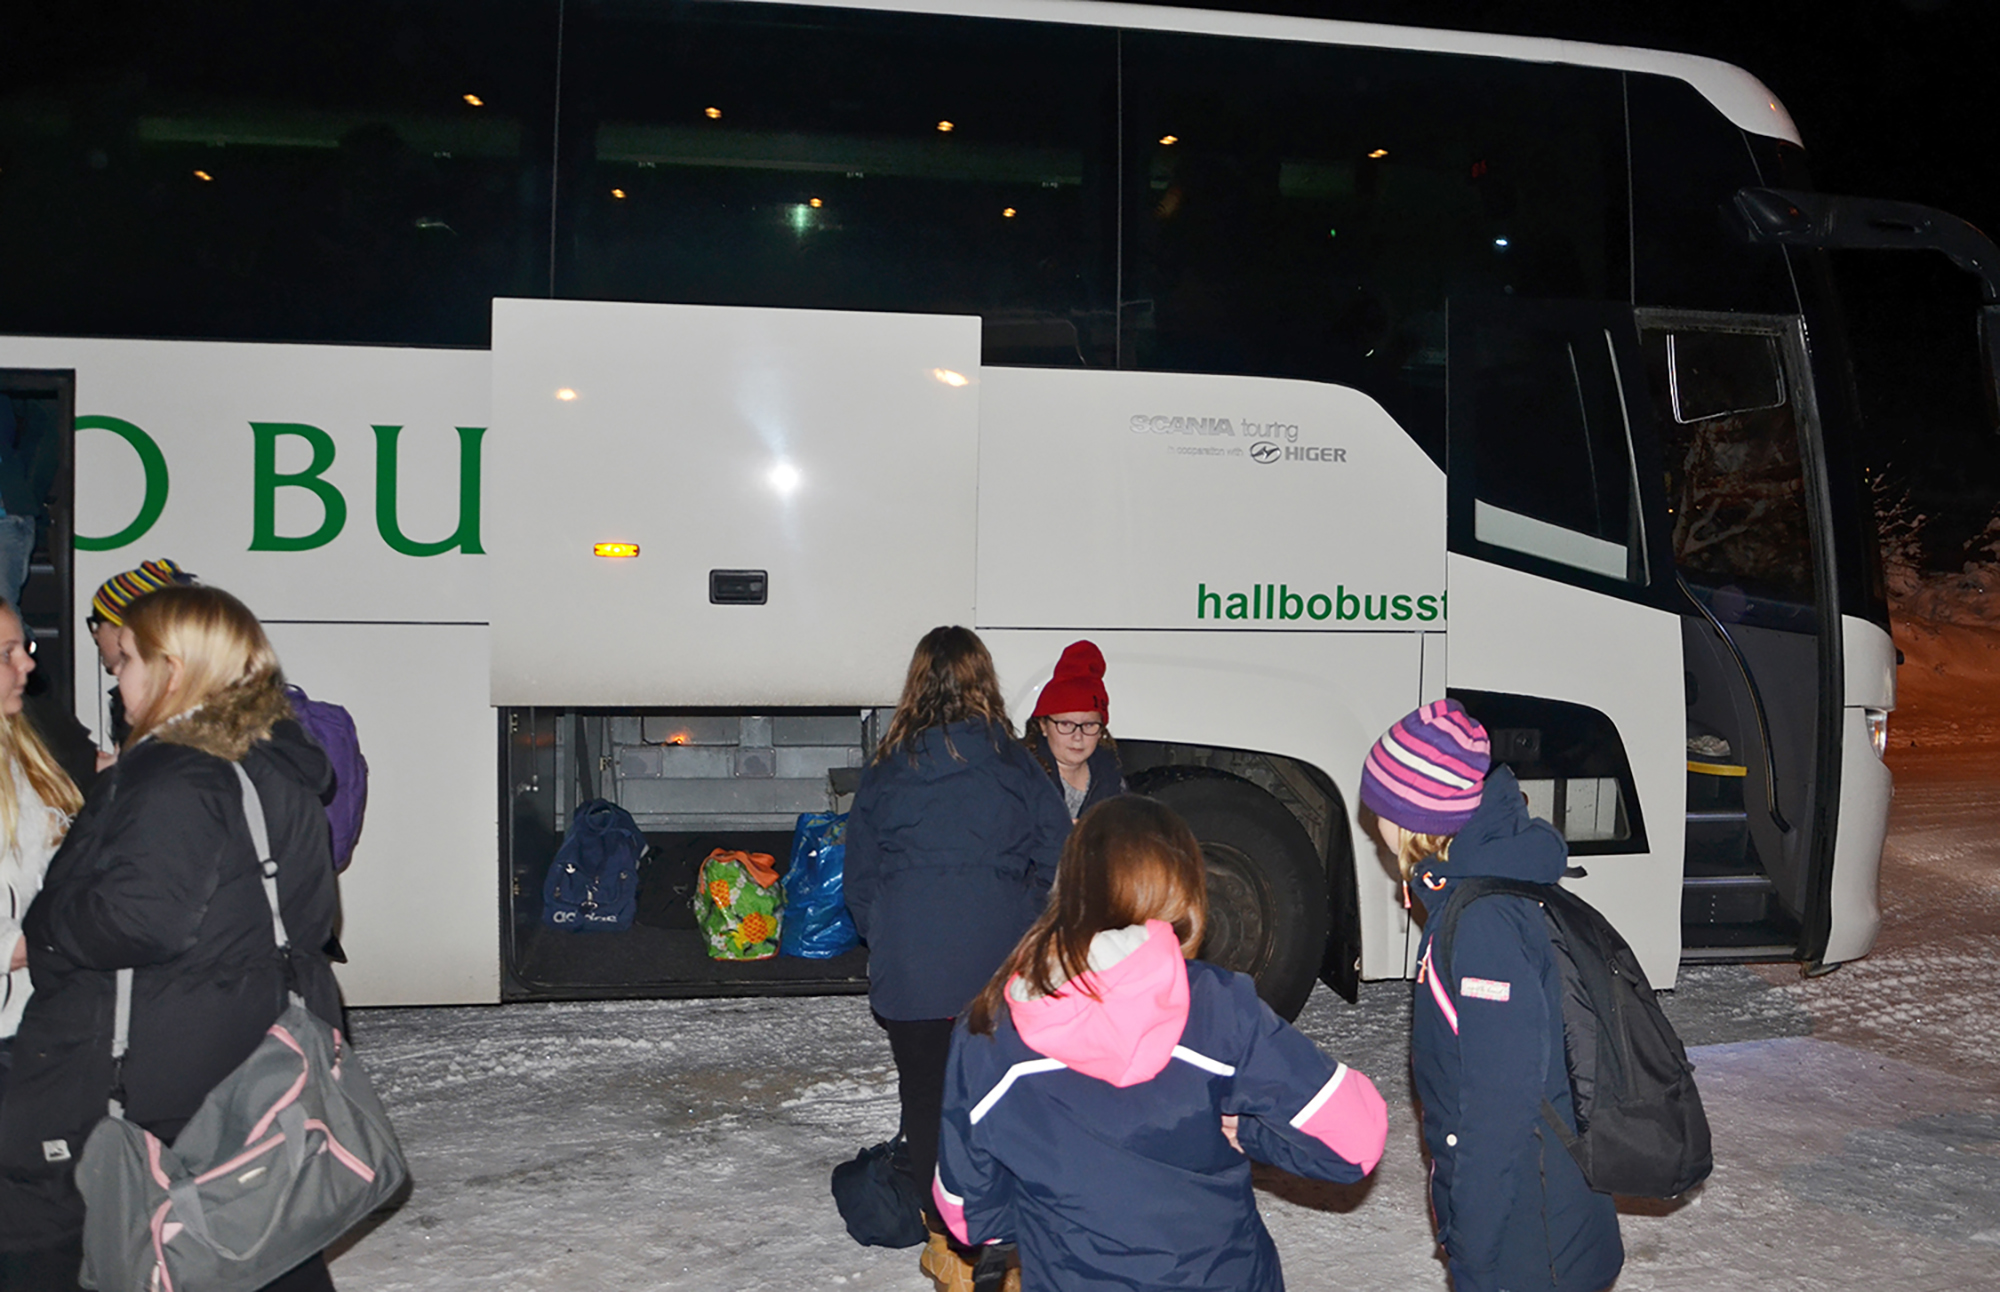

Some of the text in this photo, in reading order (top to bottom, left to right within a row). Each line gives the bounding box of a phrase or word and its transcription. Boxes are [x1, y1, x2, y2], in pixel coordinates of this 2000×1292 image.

[1130, 414, 1298, 443] SCANIA touring
[1285, 446, 1347, 463] HIGER
[248, 421, 488, 557] BU
